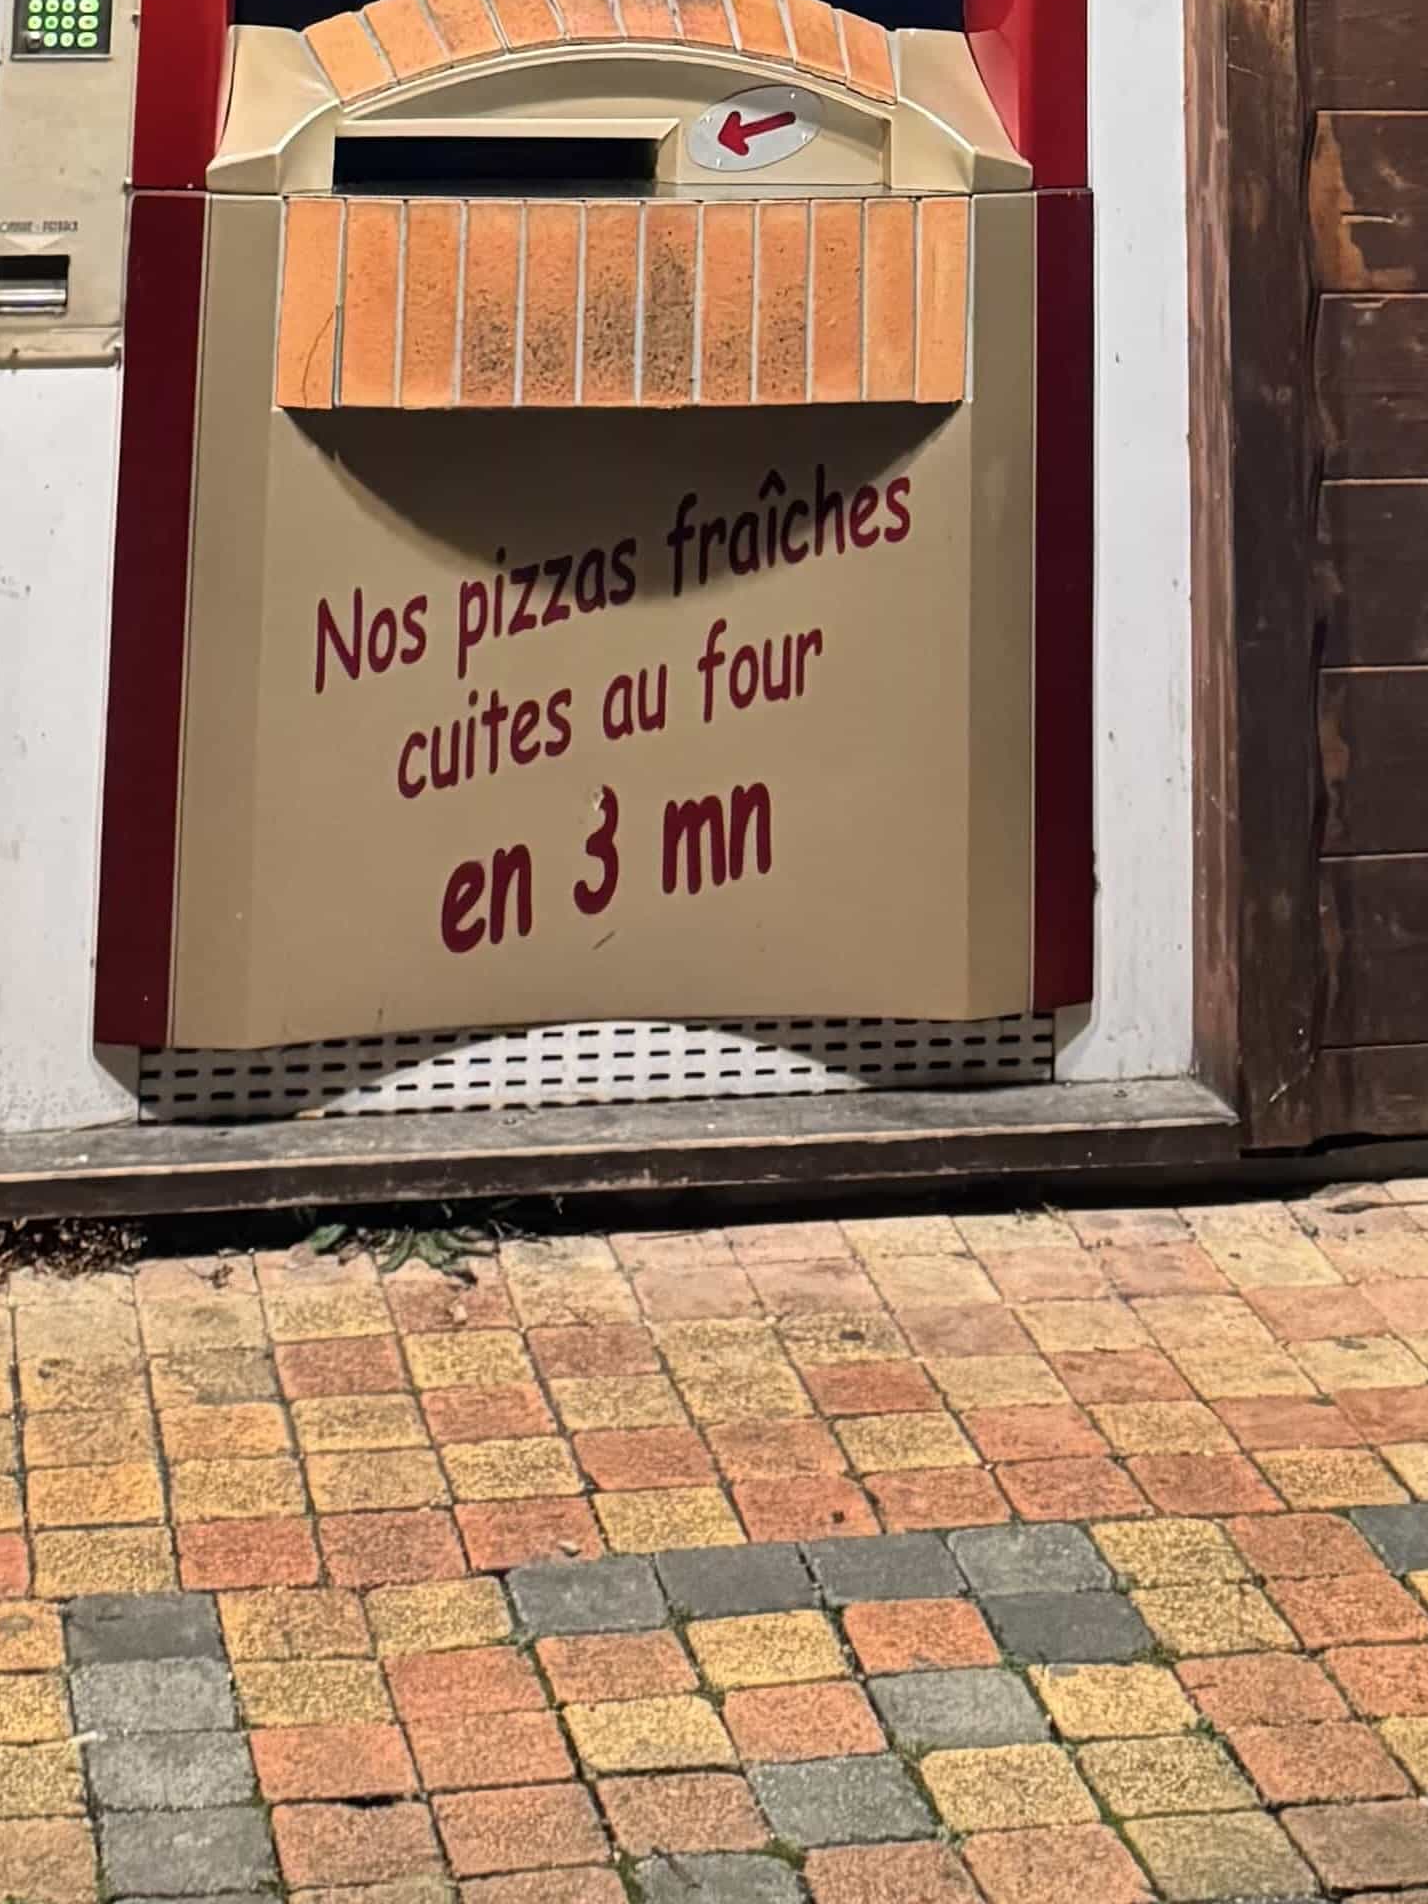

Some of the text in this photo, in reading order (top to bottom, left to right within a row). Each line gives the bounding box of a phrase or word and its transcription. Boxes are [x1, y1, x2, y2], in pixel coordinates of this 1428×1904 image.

[314, 463, 912, 694] Nos pizzas fraîches
[397, 619, 824, 799] cuites au four
[441, 782, 772, 953] en 3 mn
